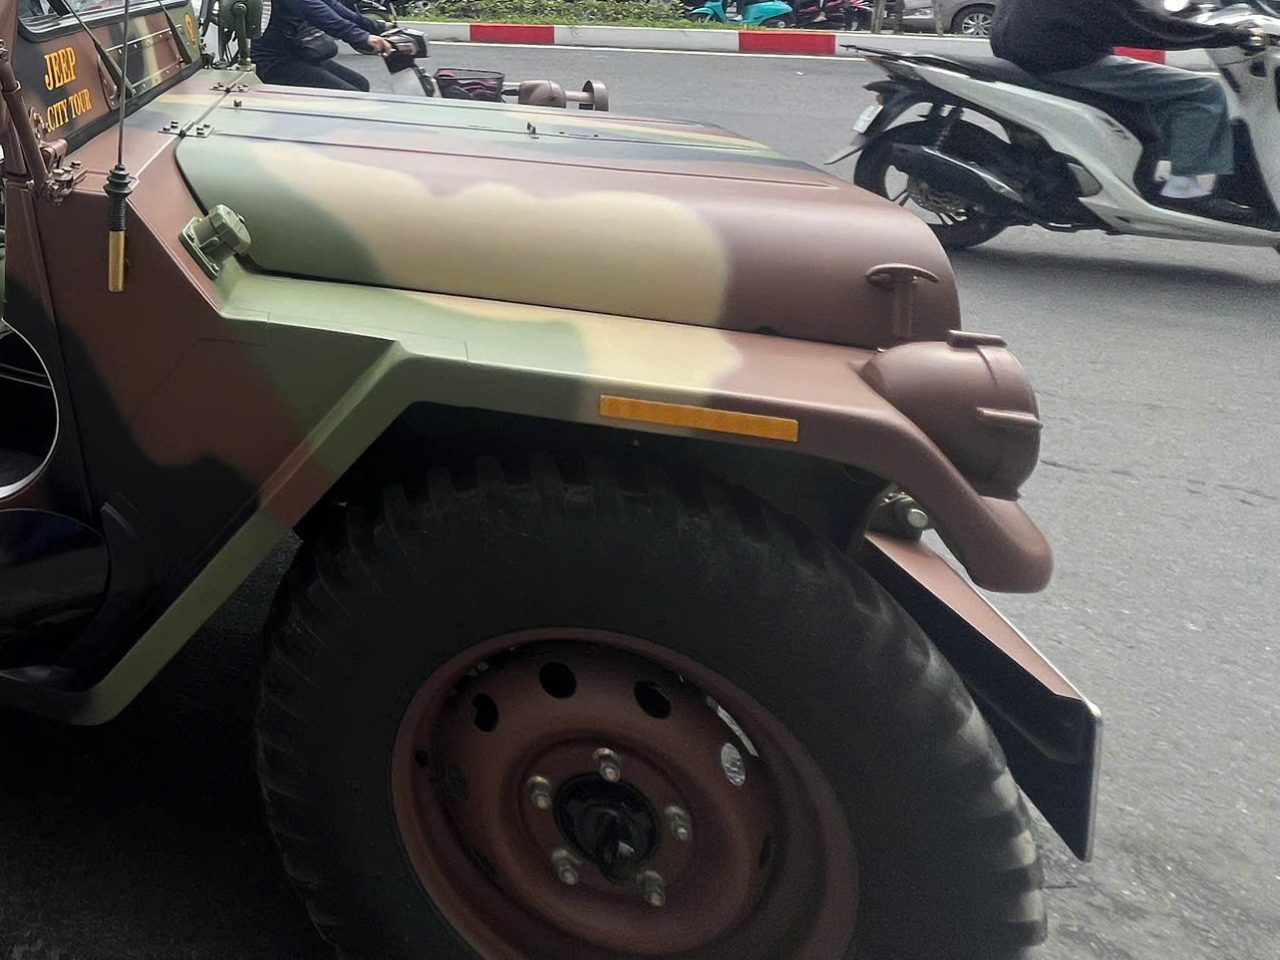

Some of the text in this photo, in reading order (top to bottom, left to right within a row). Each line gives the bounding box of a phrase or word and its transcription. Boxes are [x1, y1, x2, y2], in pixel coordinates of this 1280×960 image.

[43, 47, 77, 91] JEEP
[47, 88, 93, 132] CITY TOUR
